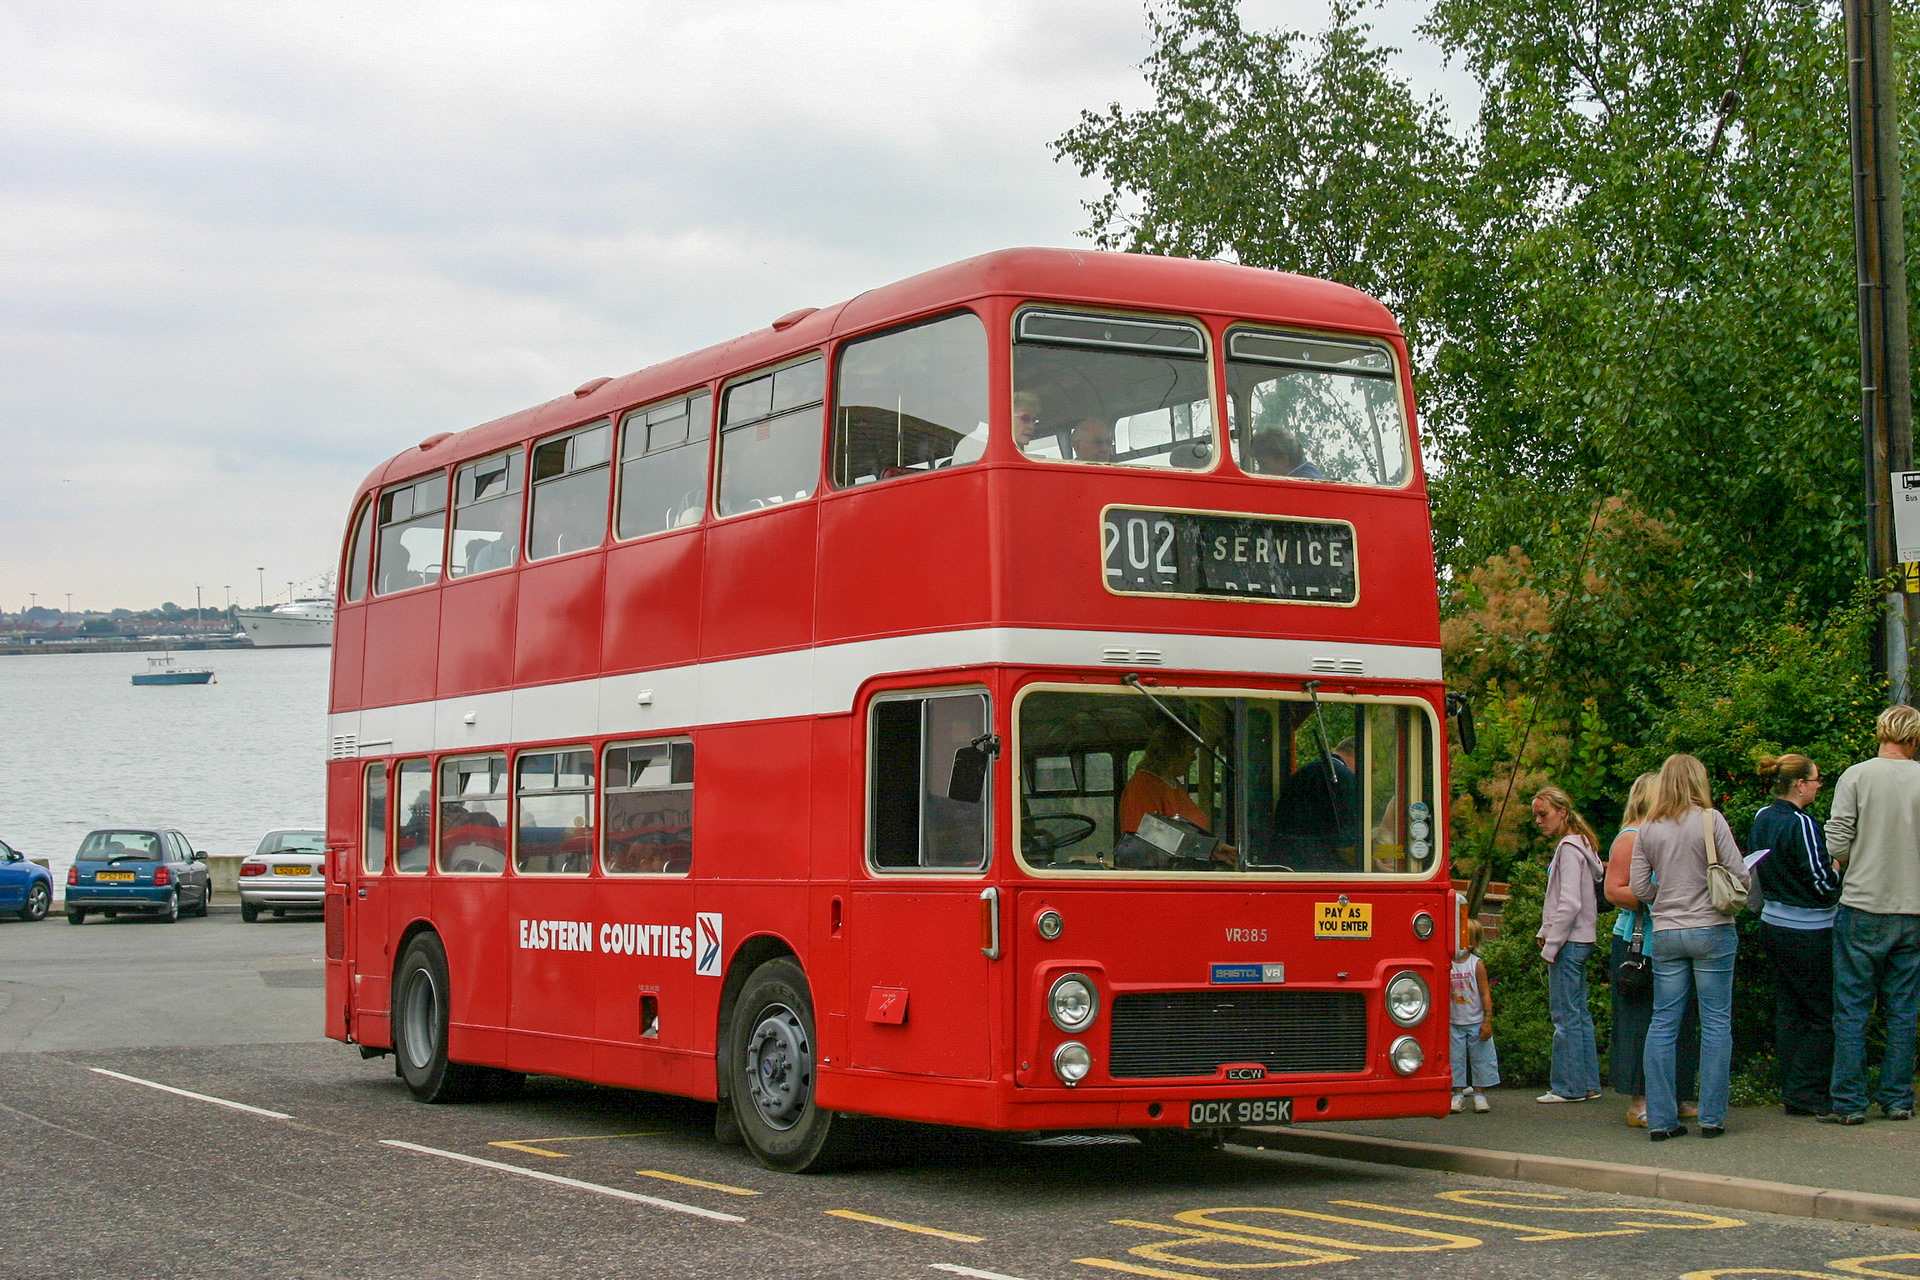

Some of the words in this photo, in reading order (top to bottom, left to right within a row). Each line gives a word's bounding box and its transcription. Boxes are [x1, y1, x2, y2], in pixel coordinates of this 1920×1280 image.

[1905, 494, 1918, 502] Bus
[1104, 518, 1178, 576] 202
[1213, 536, 1344, 567] SERVICE
[1324, 907, 1343, 918] PAY
[1348, 907, 1361, 918] AS
[1318, 920, 1338, 931] YOU
[1341, 921, 1368, 932] ENTER
[519, 919, 593, 952] EASTERN
[599, 922, 693, 960] COUNTIES
[1225, 927, 1268, 942] VR385
[1215, 968, 1260, 979] BRISTOL
[1265, 968, 1281, 978] VR
[1228, 1068, 1263, 1080] ECW
[1191, 1102, 1233, 1124] OCK
[1237, 1100, 1291, 1123] 985K
[1108, 1189, 1747, 1270] STOP
